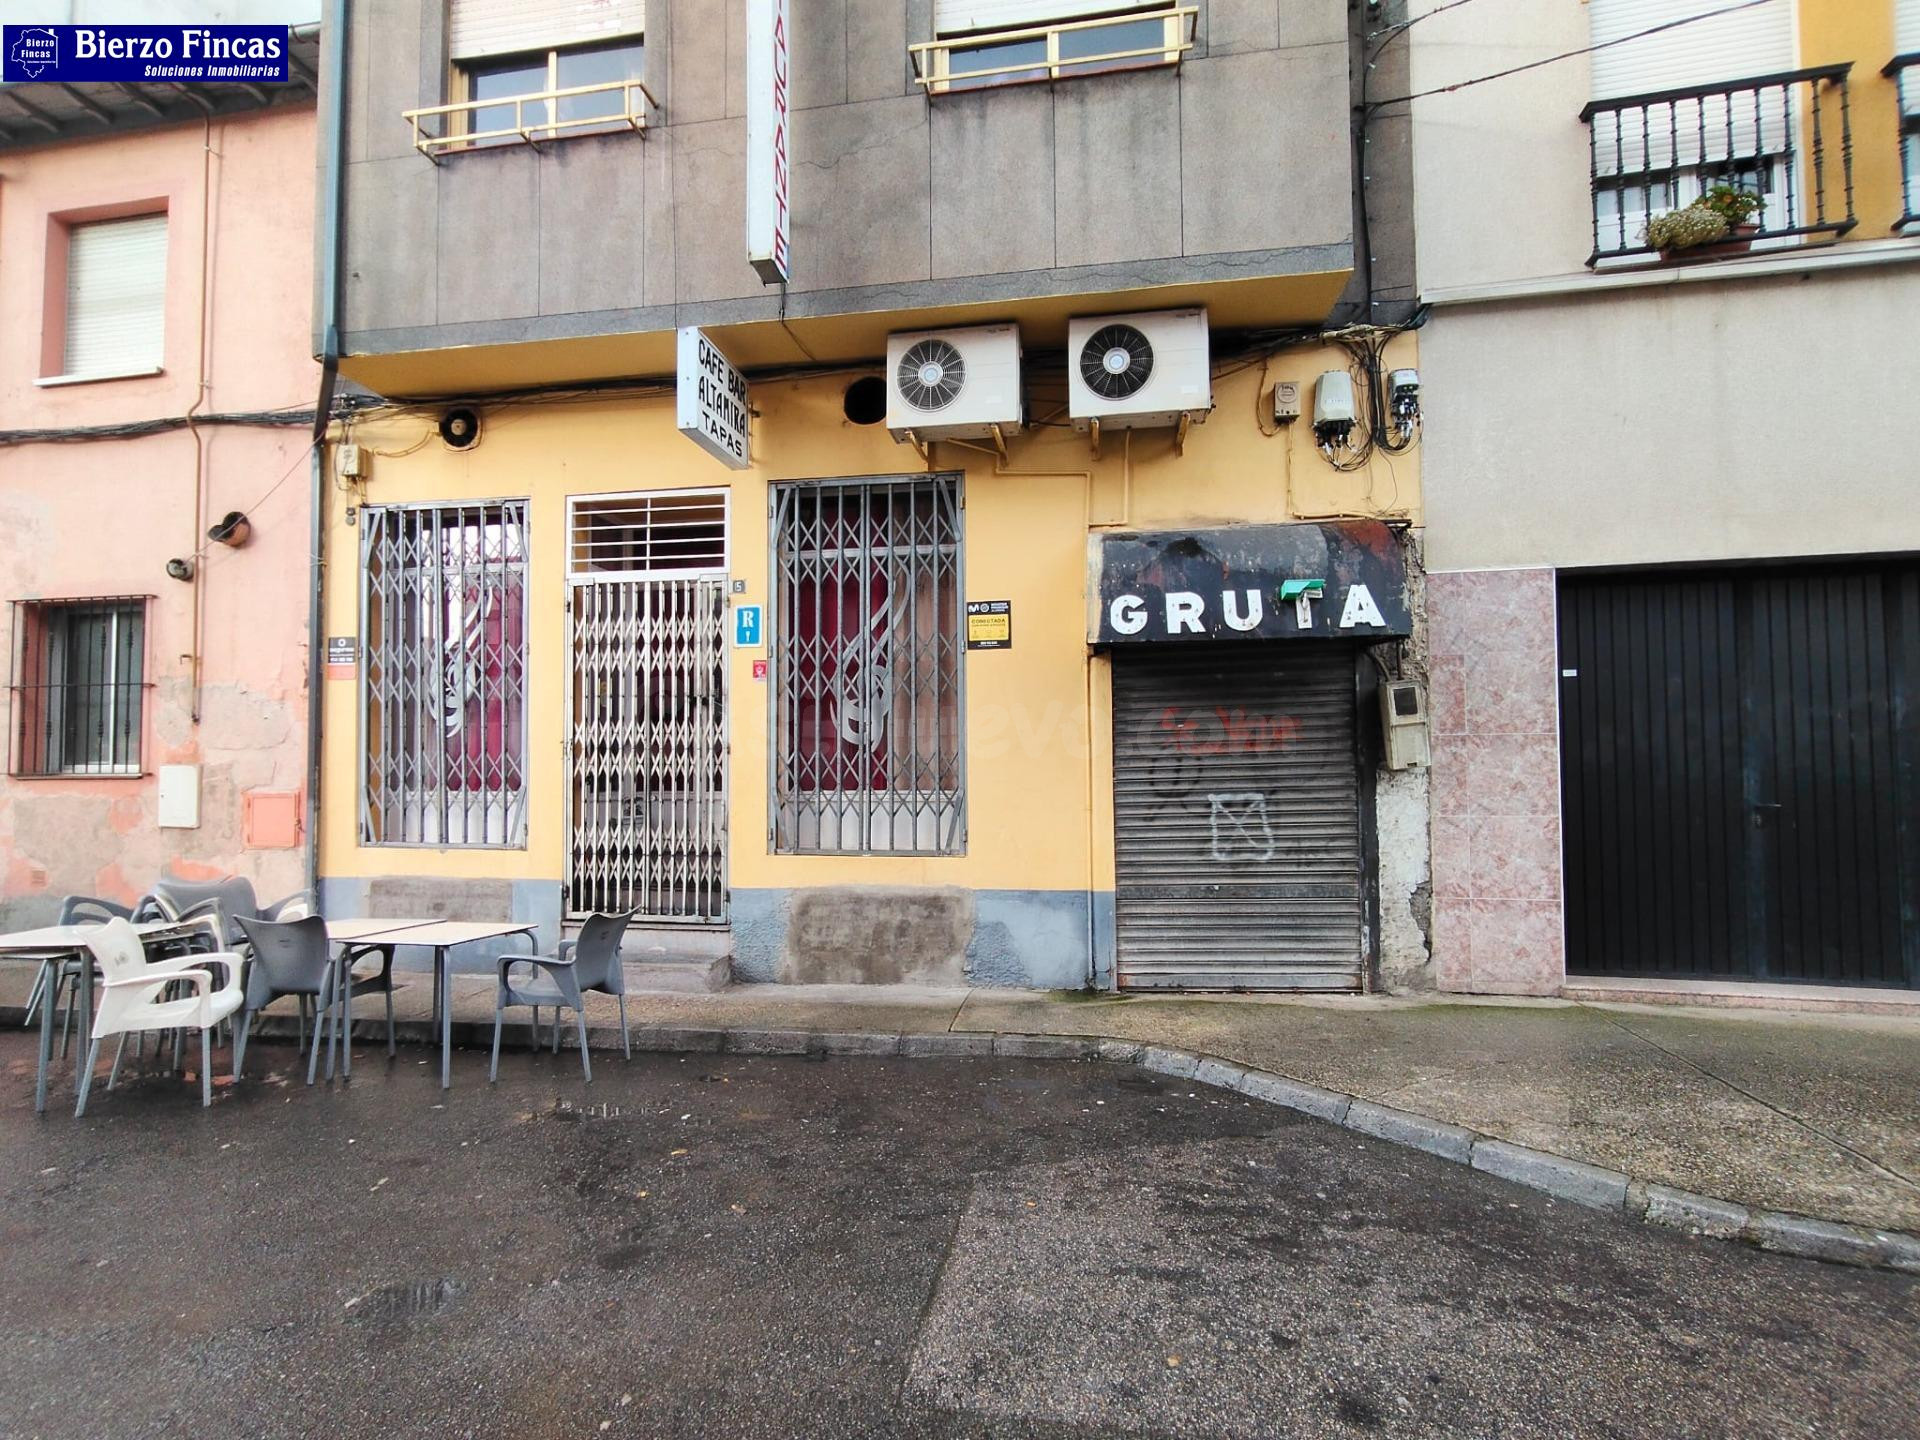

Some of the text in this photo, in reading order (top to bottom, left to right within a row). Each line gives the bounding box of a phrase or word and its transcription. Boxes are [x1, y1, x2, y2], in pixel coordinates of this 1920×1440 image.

[698, 339, 746, 406] CAFE BAR
[698, 375, 746, 438] ALTAMIRA
[702, 411, 742, 457] TAPAS
[735, 581, 742, 592] 5
[1110, 584, 1386, 635] GRUTA
[742, 610, 754, 628] R
